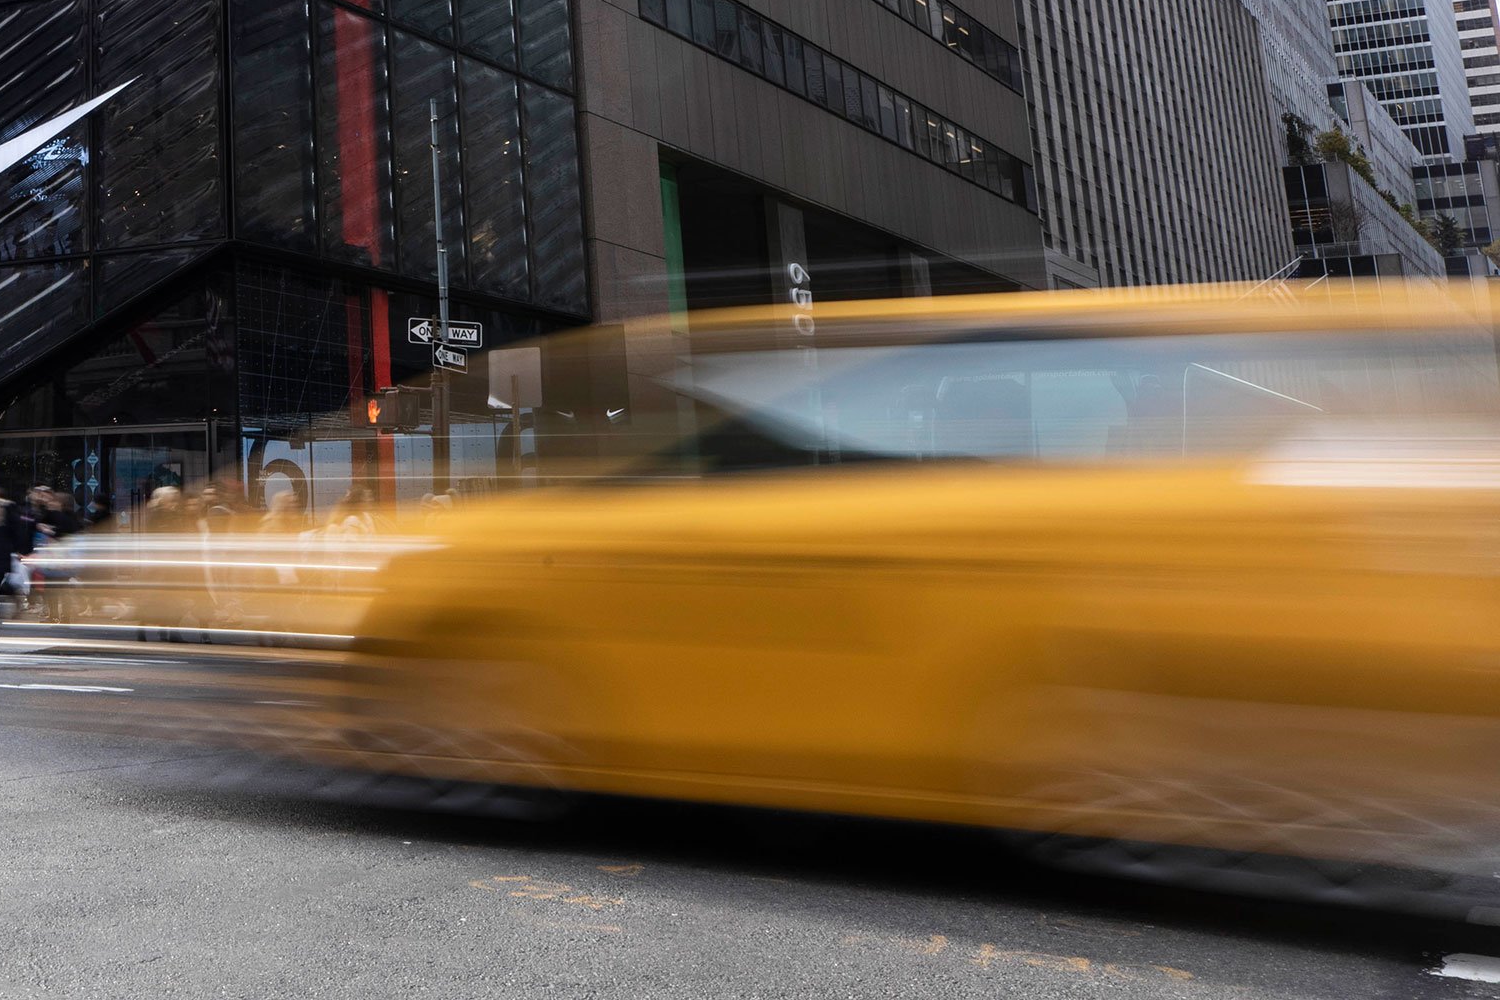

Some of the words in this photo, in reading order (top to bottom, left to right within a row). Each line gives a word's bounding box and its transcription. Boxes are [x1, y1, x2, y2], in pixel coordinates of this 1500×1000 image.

[452, 329, 475, 339] WAY
[438, 349, 449, 360] ONE
[453, 353, 464, 362] WAY
